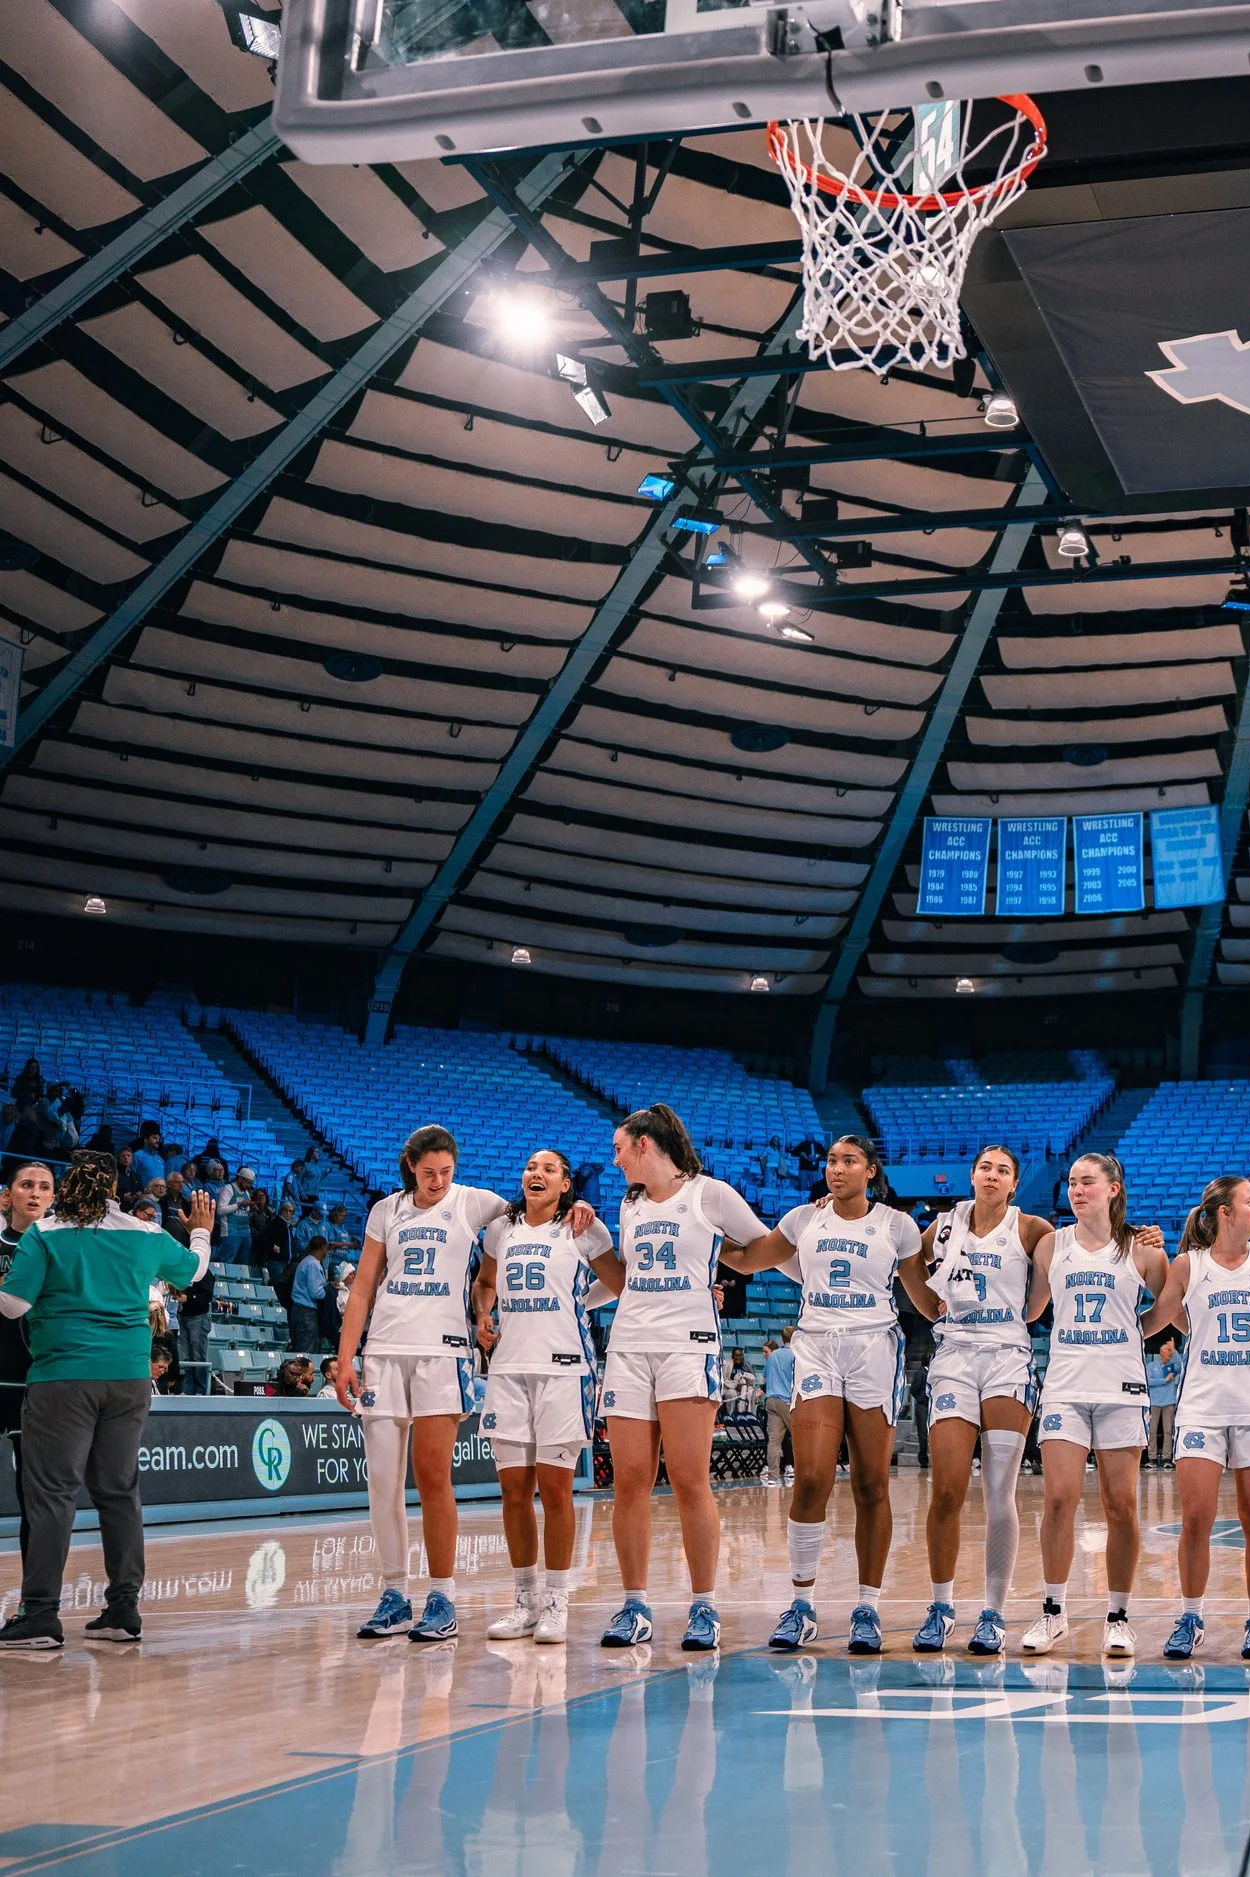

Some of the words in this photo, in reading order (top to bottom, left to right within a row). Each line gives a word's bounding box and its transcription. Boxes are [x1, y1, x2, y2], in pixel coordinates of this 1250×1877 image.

[932, 822, 983, 833] WRESTLING
[1007, 821, 1058, 832] WRESTLING
[1082, 818, 1134, 831] WRESTLING
[946, 836, 966, 846] ACC
[1023, 835, 1042, 846] ACC
[1099, 832, 1119, 843] ACC
[928, 850, 981, 861] CHAMPIONS
[1005, 849, 1058, 860] CHAMPIONS
[1081, 845, 1136, 859] CHAMPIONS
[373, 1002, 389, 1012] 215
[398, 1226, 448, 1244] NORTH
[634, 1220, 680, 1238] NORTH
[505, 1243, 552, 1259] NORTH
[635, 1241, 677, 1270] 34
[816, 1238, 869, 1258] NORTH
[403, 1247, 436, 1275] 21
[505, 1262, 545, 1291] 26
[829, 1259, 851, 1288] 2
[1065, 1272, 1116, 1289] NORTH
[387, 1280, 450, 1297] CAROLINA
[807, 1292, 877, 1308] CAROLINA
[1074, 1293, 1107, 1323] 17
[1058, 1328, 1129, 1344] CAROLINA
[253, 1385, 266, 1396] POSS.
[302, 1424, 328, 1449] WE
[317, 1458, 348, 1485] FOR
